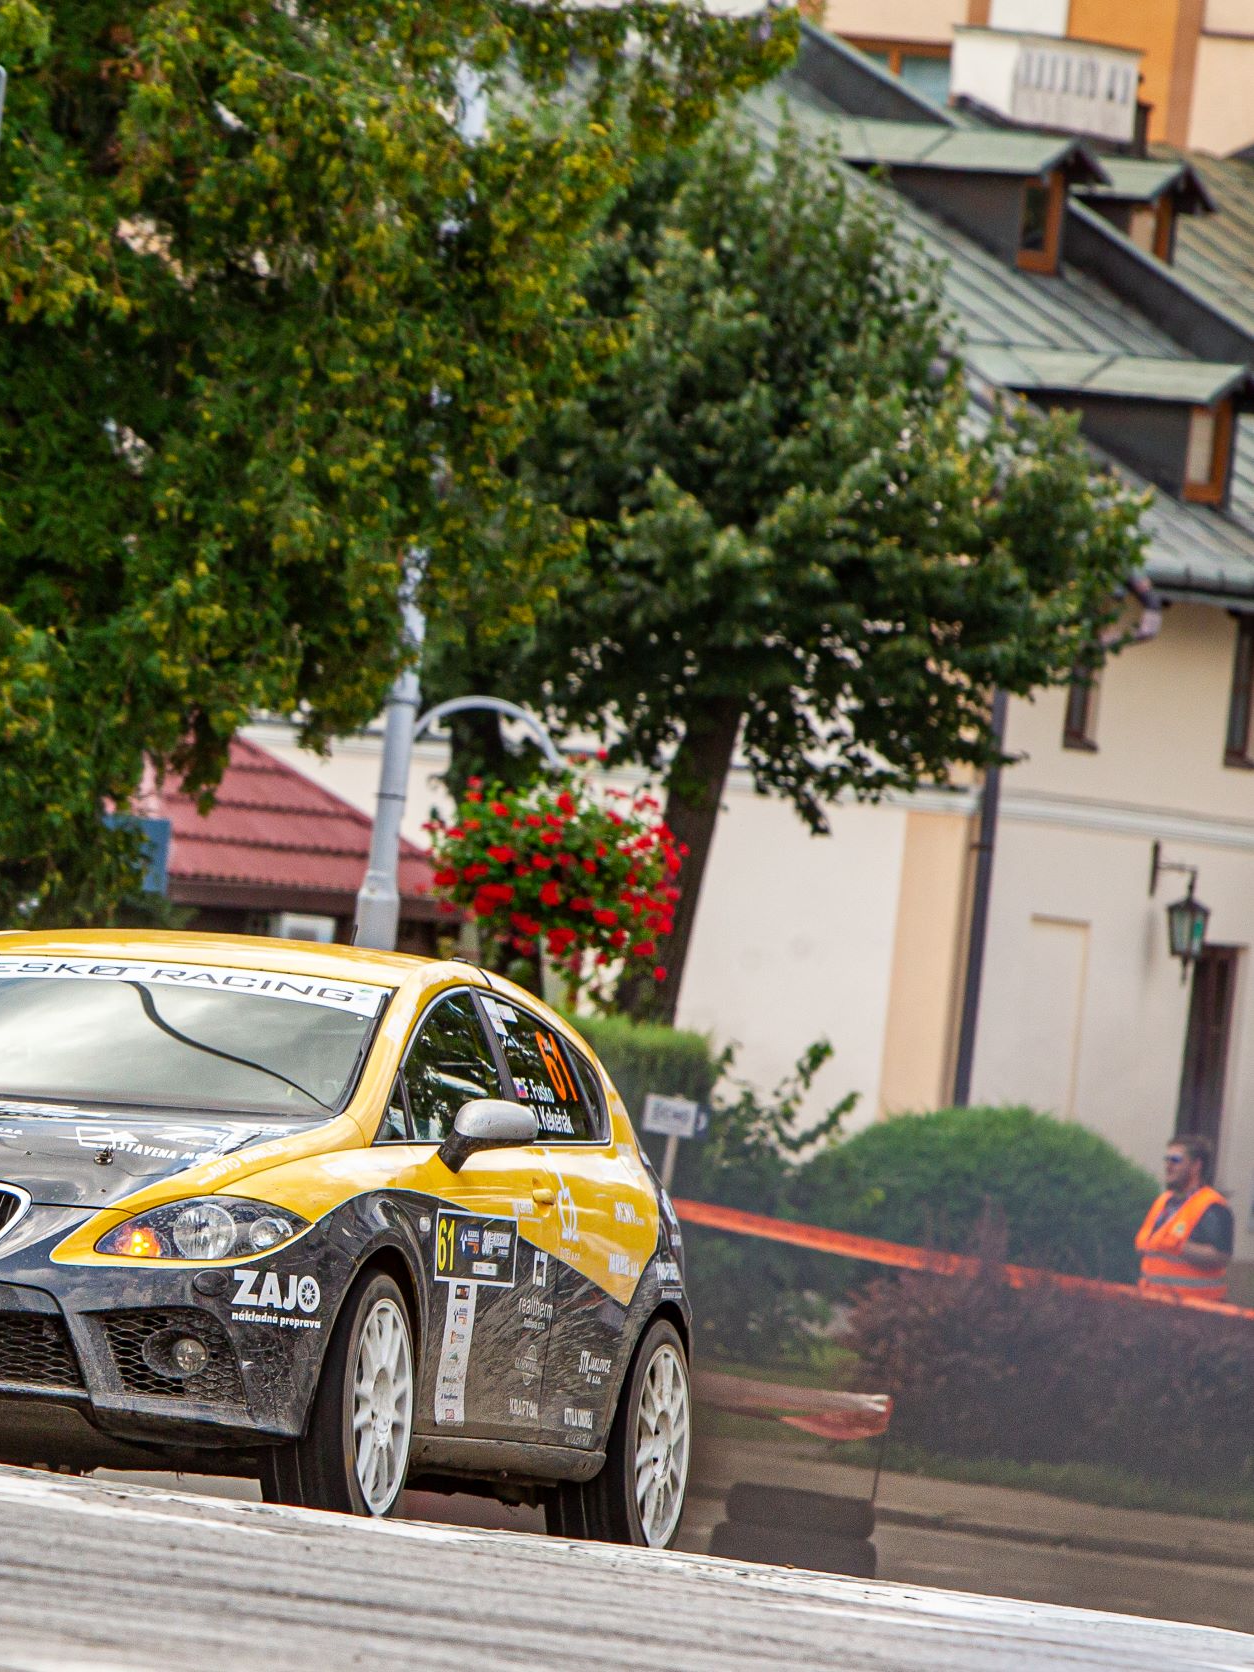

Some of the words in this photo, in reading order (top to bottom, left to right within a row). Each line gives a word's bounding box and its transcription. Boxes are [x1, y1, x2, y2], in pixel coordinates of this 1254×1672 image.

[151, 969, 355, 1002] RACING
[437, 1218, 456, 1272] 61
[231, 1269, 321, 1313] ZAJO
[518, 1295, 554, 1320] realtherm
[279, 1316, 322, 1329] preprava
